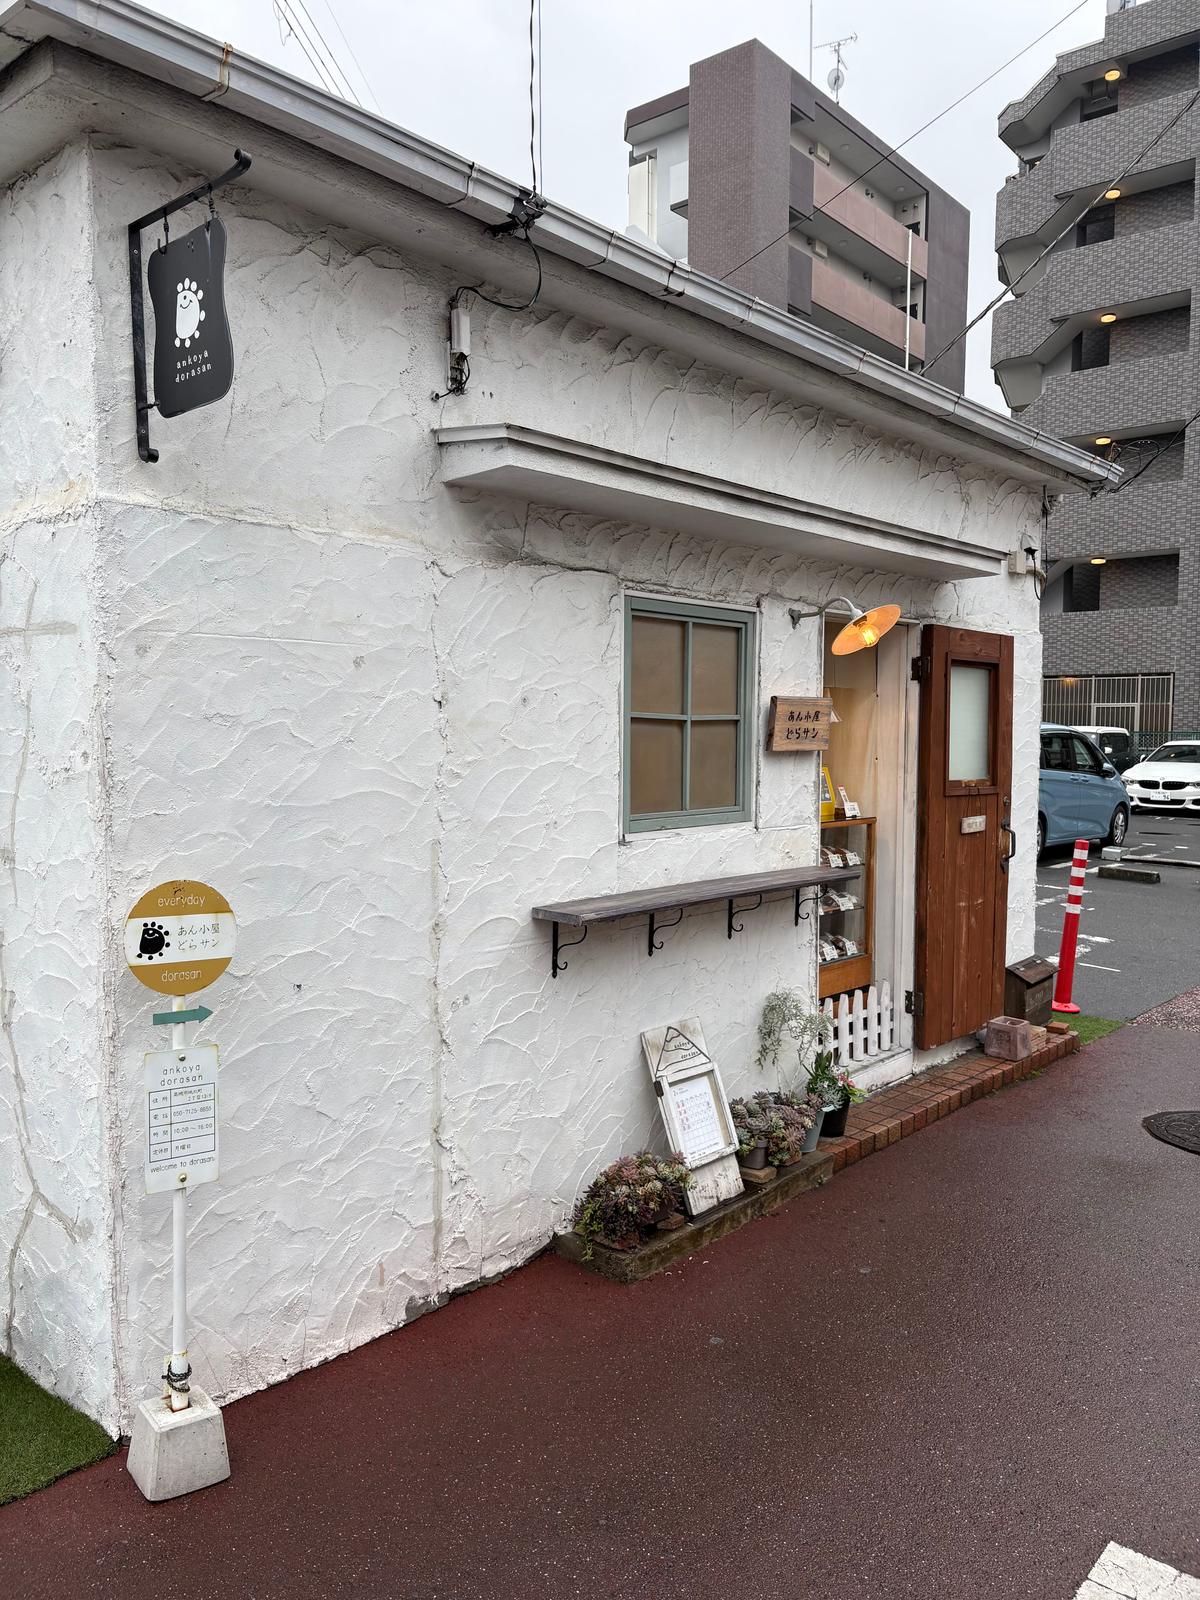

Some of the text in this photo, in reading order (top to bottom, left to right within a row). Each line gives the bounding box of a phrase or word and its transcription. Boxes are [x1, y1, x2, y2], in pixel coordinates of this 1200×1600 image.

[176, 350, 208, 369] ankoya
[175, 363, 211, 383] dorasan
[787, 710, 821, 722] あん小屋
[786, 727, 819, 740] どらサン
[157, 893, 206, 908] everyday
[177, 923, 220, 937] あん小屋
[177, 938, 220, 951] どらサン
[161, 969, 202, 982] dorasan
[162, 1064, 201, 1075] ankoya
[160, 1074, 203, 1087] dorasan
[150, 1163, 178, 1173] welcome
